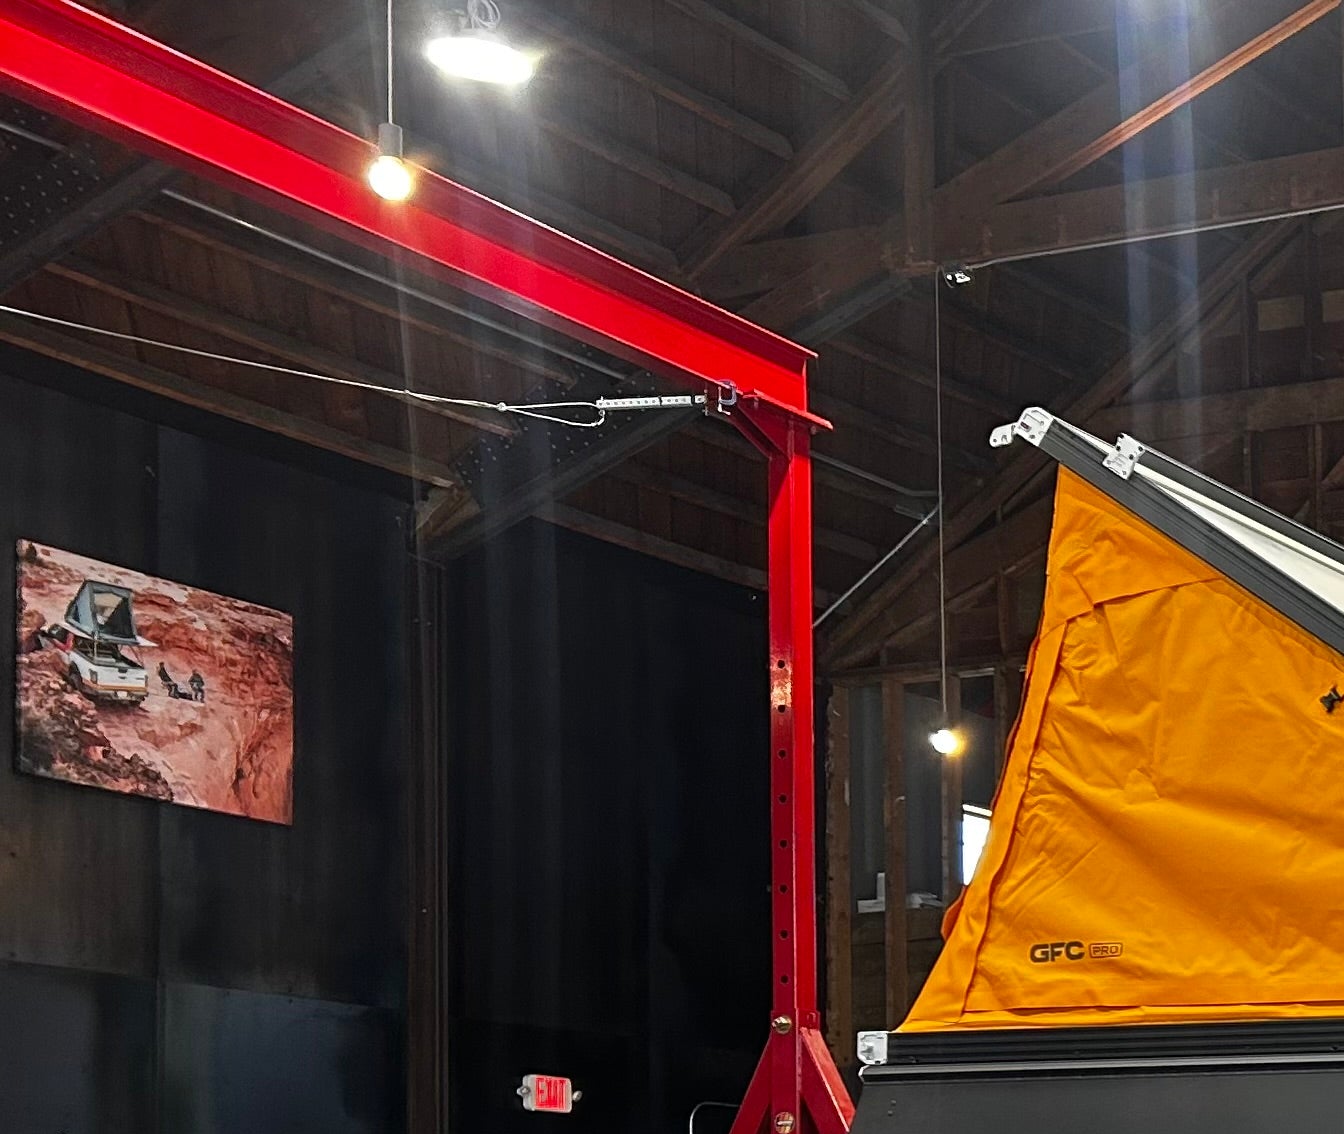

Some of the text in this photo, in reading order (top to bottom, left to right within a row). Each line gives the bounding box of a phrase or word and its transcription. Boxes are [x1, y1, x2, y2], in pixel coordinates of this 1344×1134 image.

[1029, 940, 1119, 963] GFC PRO
[535, 1076, 567, 1110] EXIT
